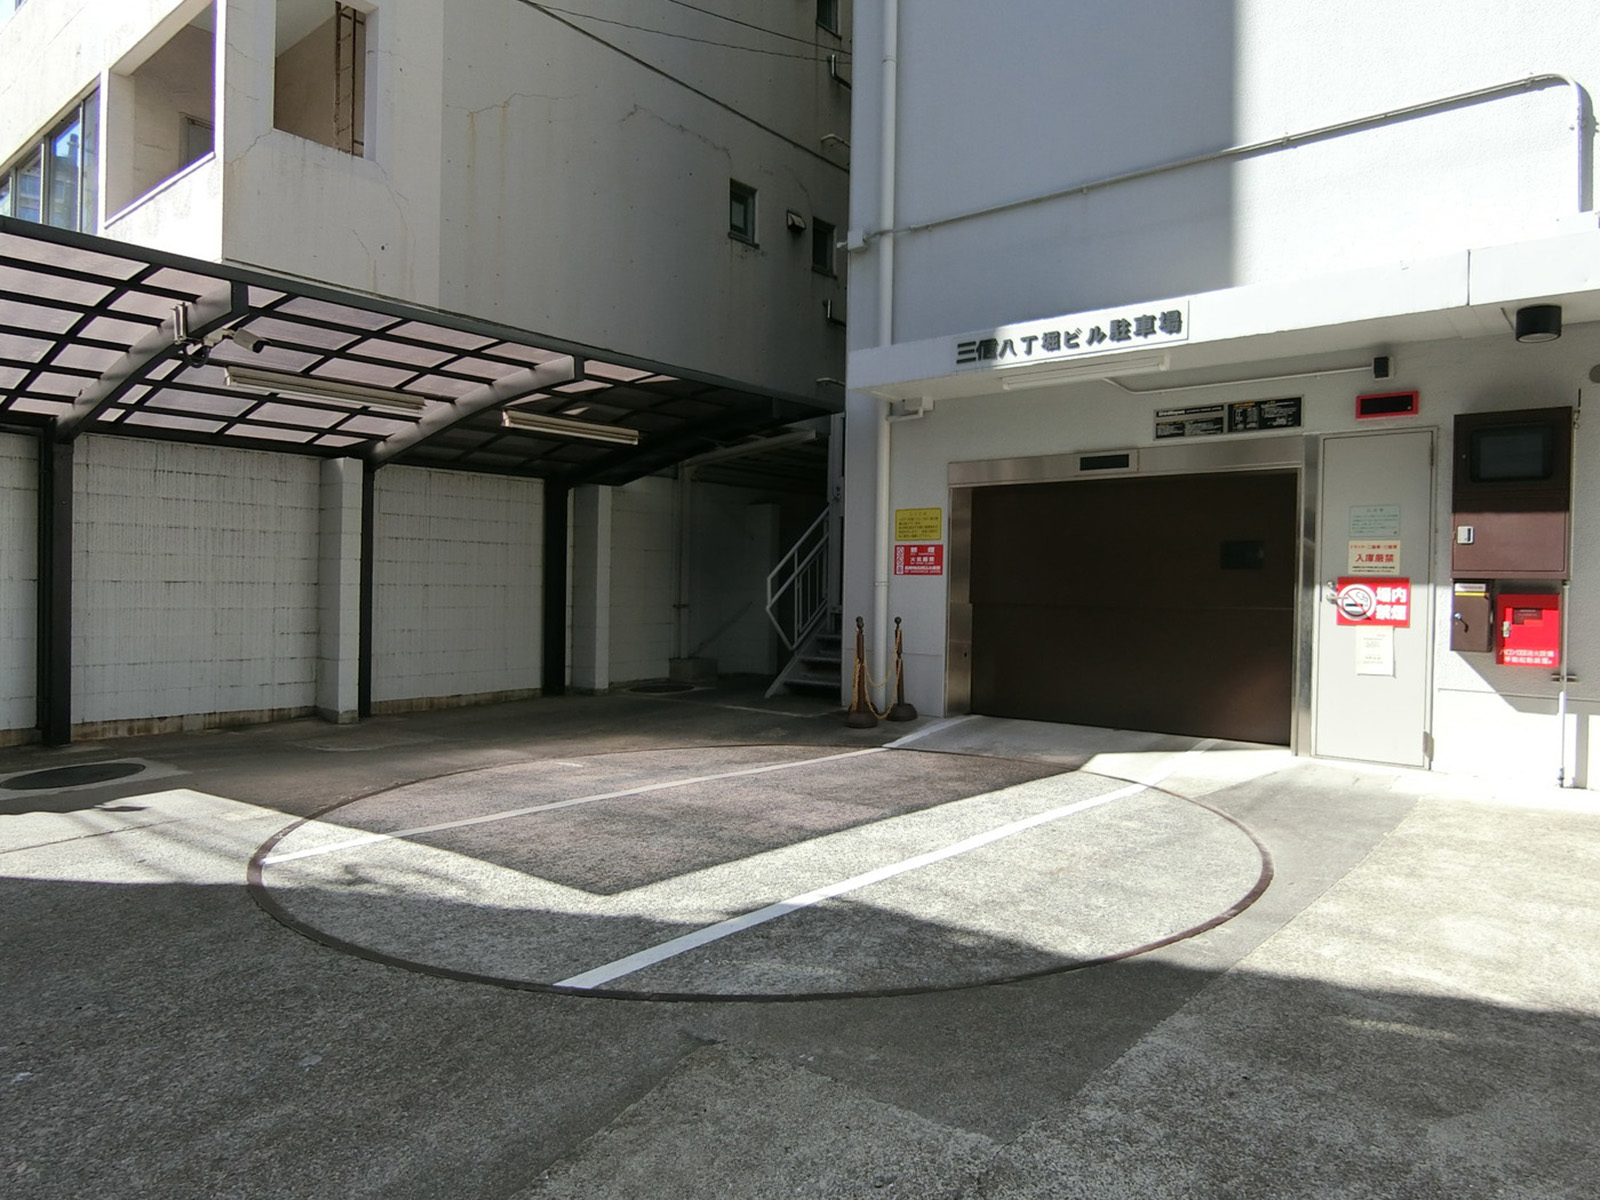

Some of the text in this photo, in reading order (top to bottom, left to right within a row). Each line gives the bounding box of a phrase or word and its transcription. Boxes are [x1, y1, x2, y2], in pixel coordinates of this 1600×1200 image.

[956, 310, 1182, 364] 三信八丁堀ビル駐車場
[1375, 586, 1408, 603] 場内
[1375, 604, 1408, 620] 禁煙
